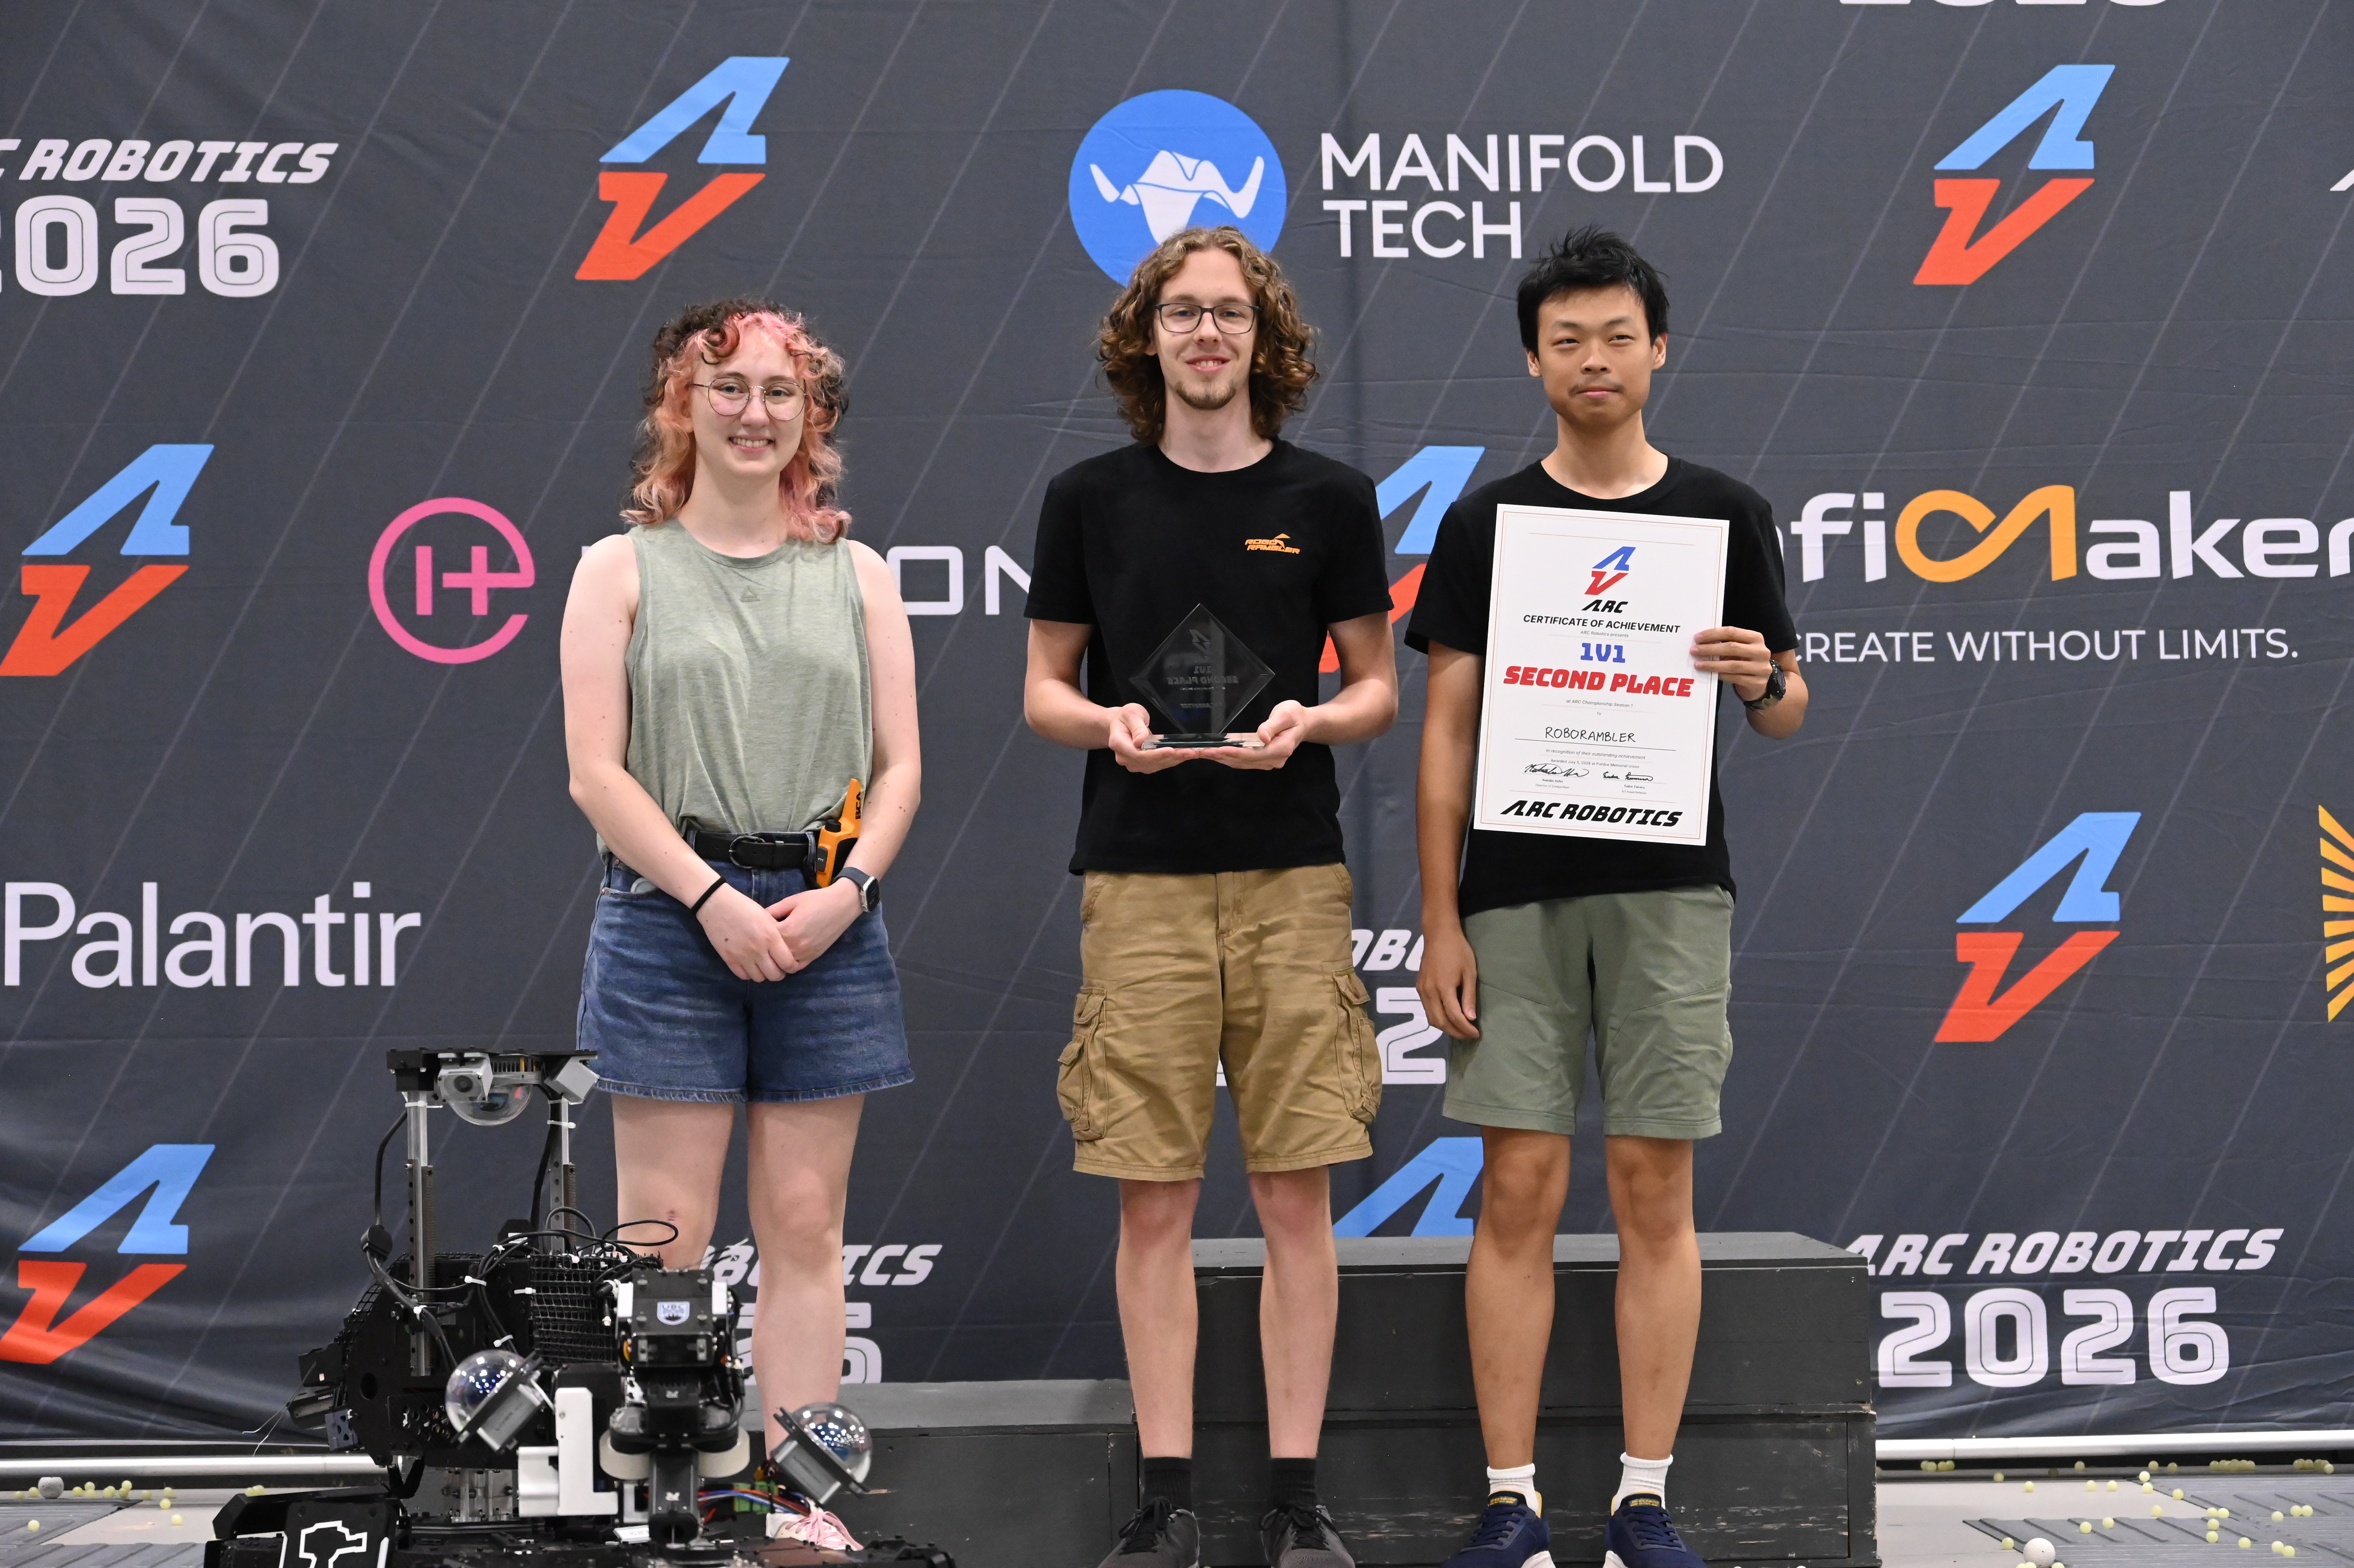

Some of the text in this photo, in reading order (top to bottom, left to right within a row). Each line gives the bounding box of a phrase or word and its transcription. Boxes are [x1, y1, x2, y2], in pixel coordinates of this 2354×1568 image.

[18, 138, 339, 183] ROBOTICS
[1321, 133, 1724, 192] MANIFOLD
[0, 195, 279, 297] 026
[1323, 200, 1522, 259] TECH
[1523, 615, 1681, 633] CERTIFICATE OF ACHIEVEMENT
[1581, 599, 1628, 613] ARC
[1946, 630, 2146, 661] WITHOUT
[2159, 628, 2298, 660] LIMITS.
[1503, 665, 1695, 697] SECOND PLACE
[1545, 726, 1636, 742] ROBORAMBLER
[1500, 800, 1683, 827] ARC ROBOTICS
[4, 881, 421, 988] Palantir
[1967, 1228, 2284, 1275] ROBOTICS
[1877, 1287, 2229, 1388] 2026
